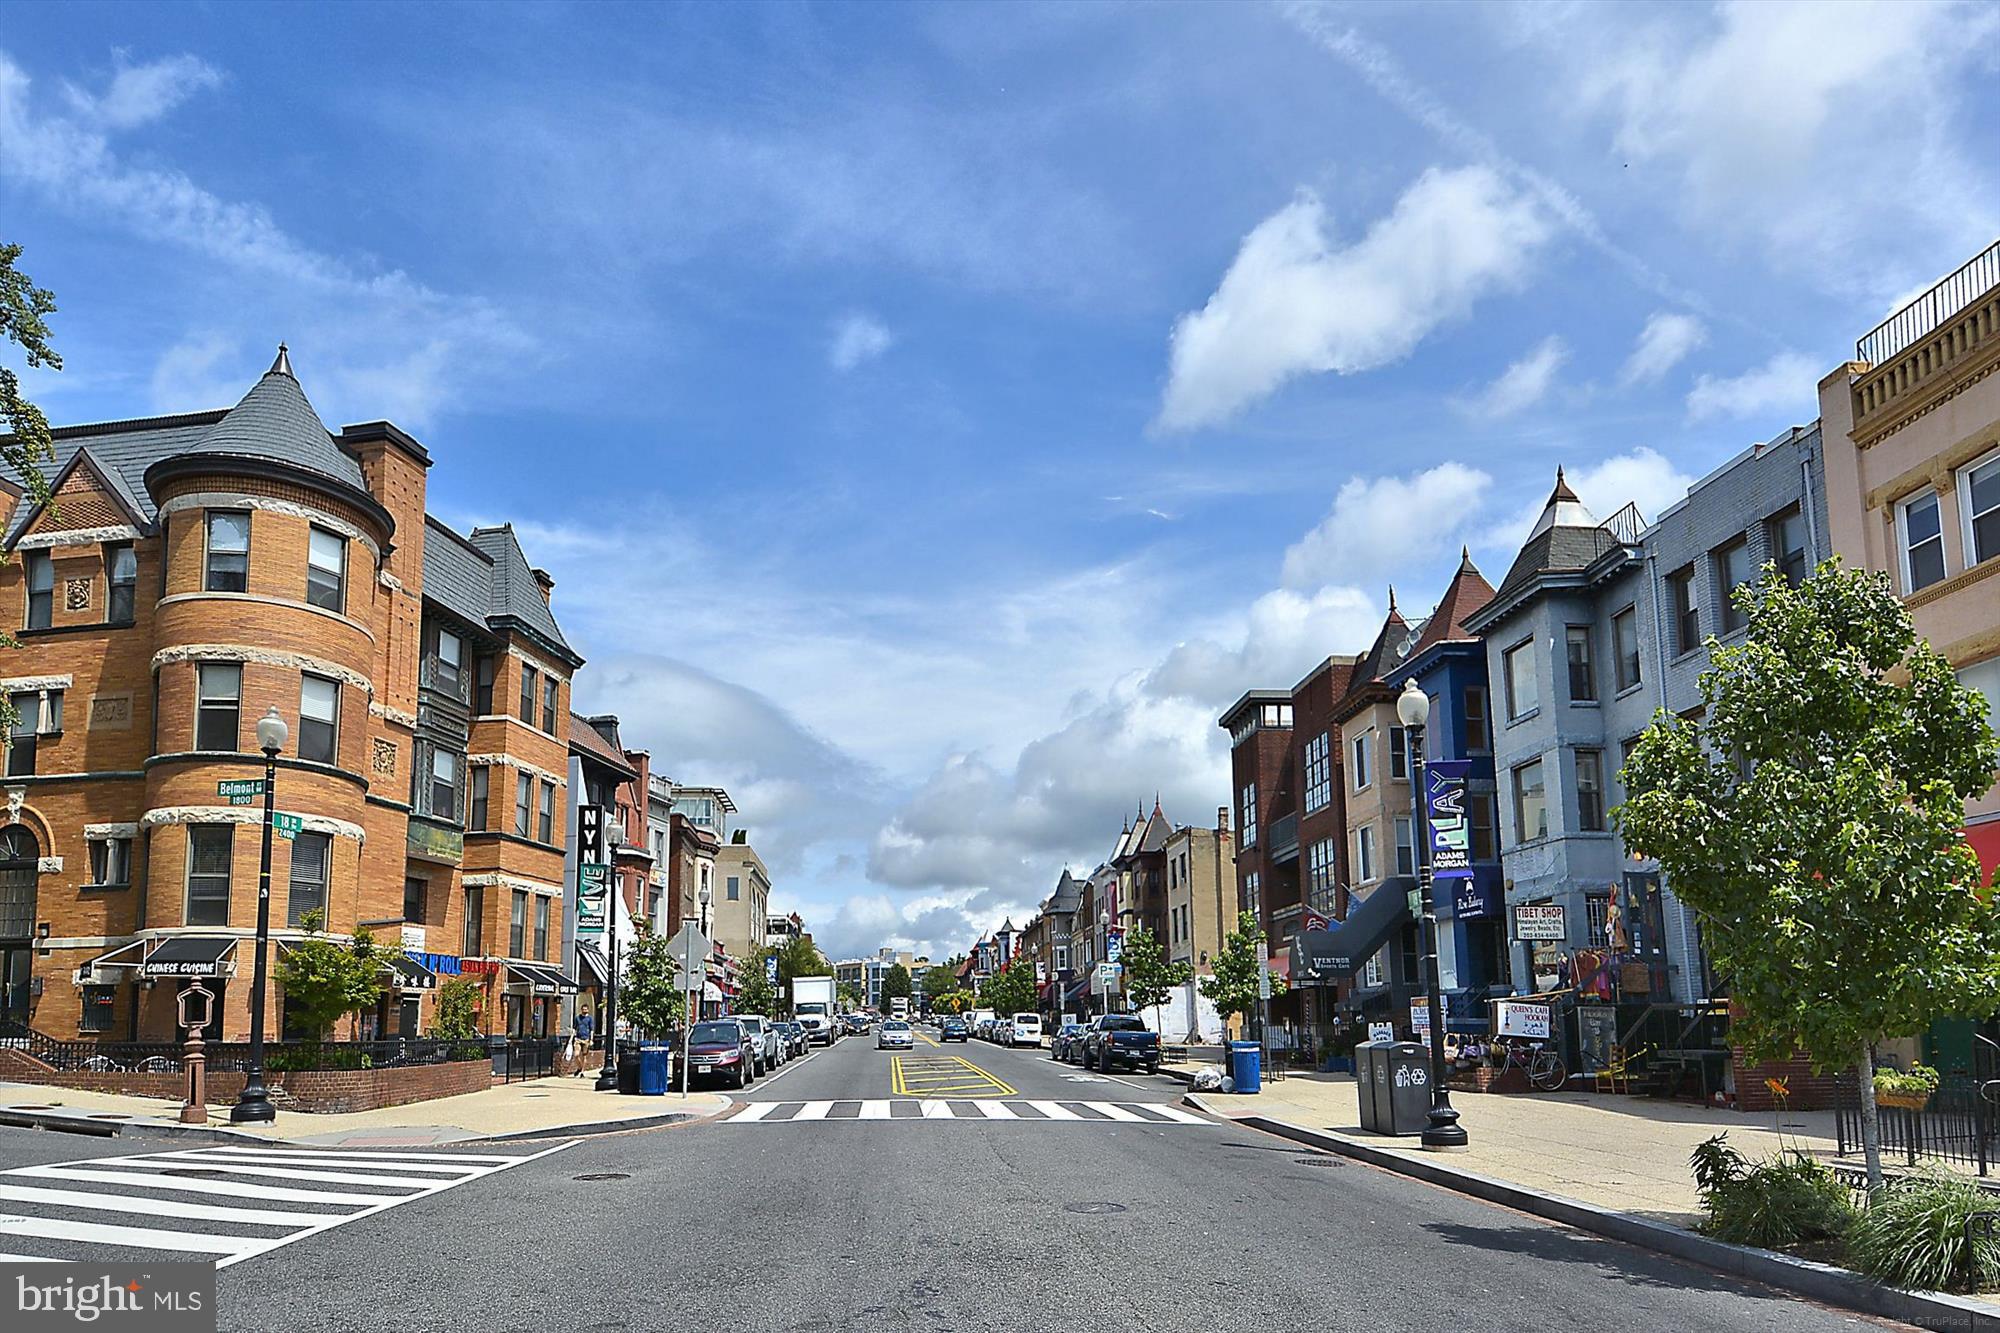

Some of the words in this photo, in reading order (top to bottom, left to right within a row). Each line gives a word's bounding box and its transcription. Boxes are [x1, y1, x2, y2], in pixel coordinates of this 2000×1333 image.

[220, 782, 254, 794] Belmont
[233, 796, 250, 804] 1800
[1431, 770, 1467, 849] PLAY
[280, 815, 290, 828] 18
[279, 829, 295, 838] 2400
[1436, 852, 1465, 860] ADAMS
[1433, 859, 1469, 868] MORGAN
[581, 866, 605, 916] LIVE
[1517, 907, 1538, 918] TIBET
[1541, 907, 1562, 918] SHOP
[146, 963, 178, 974] CHINESE
[180, 962, 215, 974] CUISINE
[439, 955, 462, 976] ROLL
[462, 960, 479, 972] ASIAN
[1313, 958, 1350, 968] VENTNOR
[1511, 1005, 1533, 1014] QUEEN'S
[1524, 1013, 1548, 1021] HOOKAH
